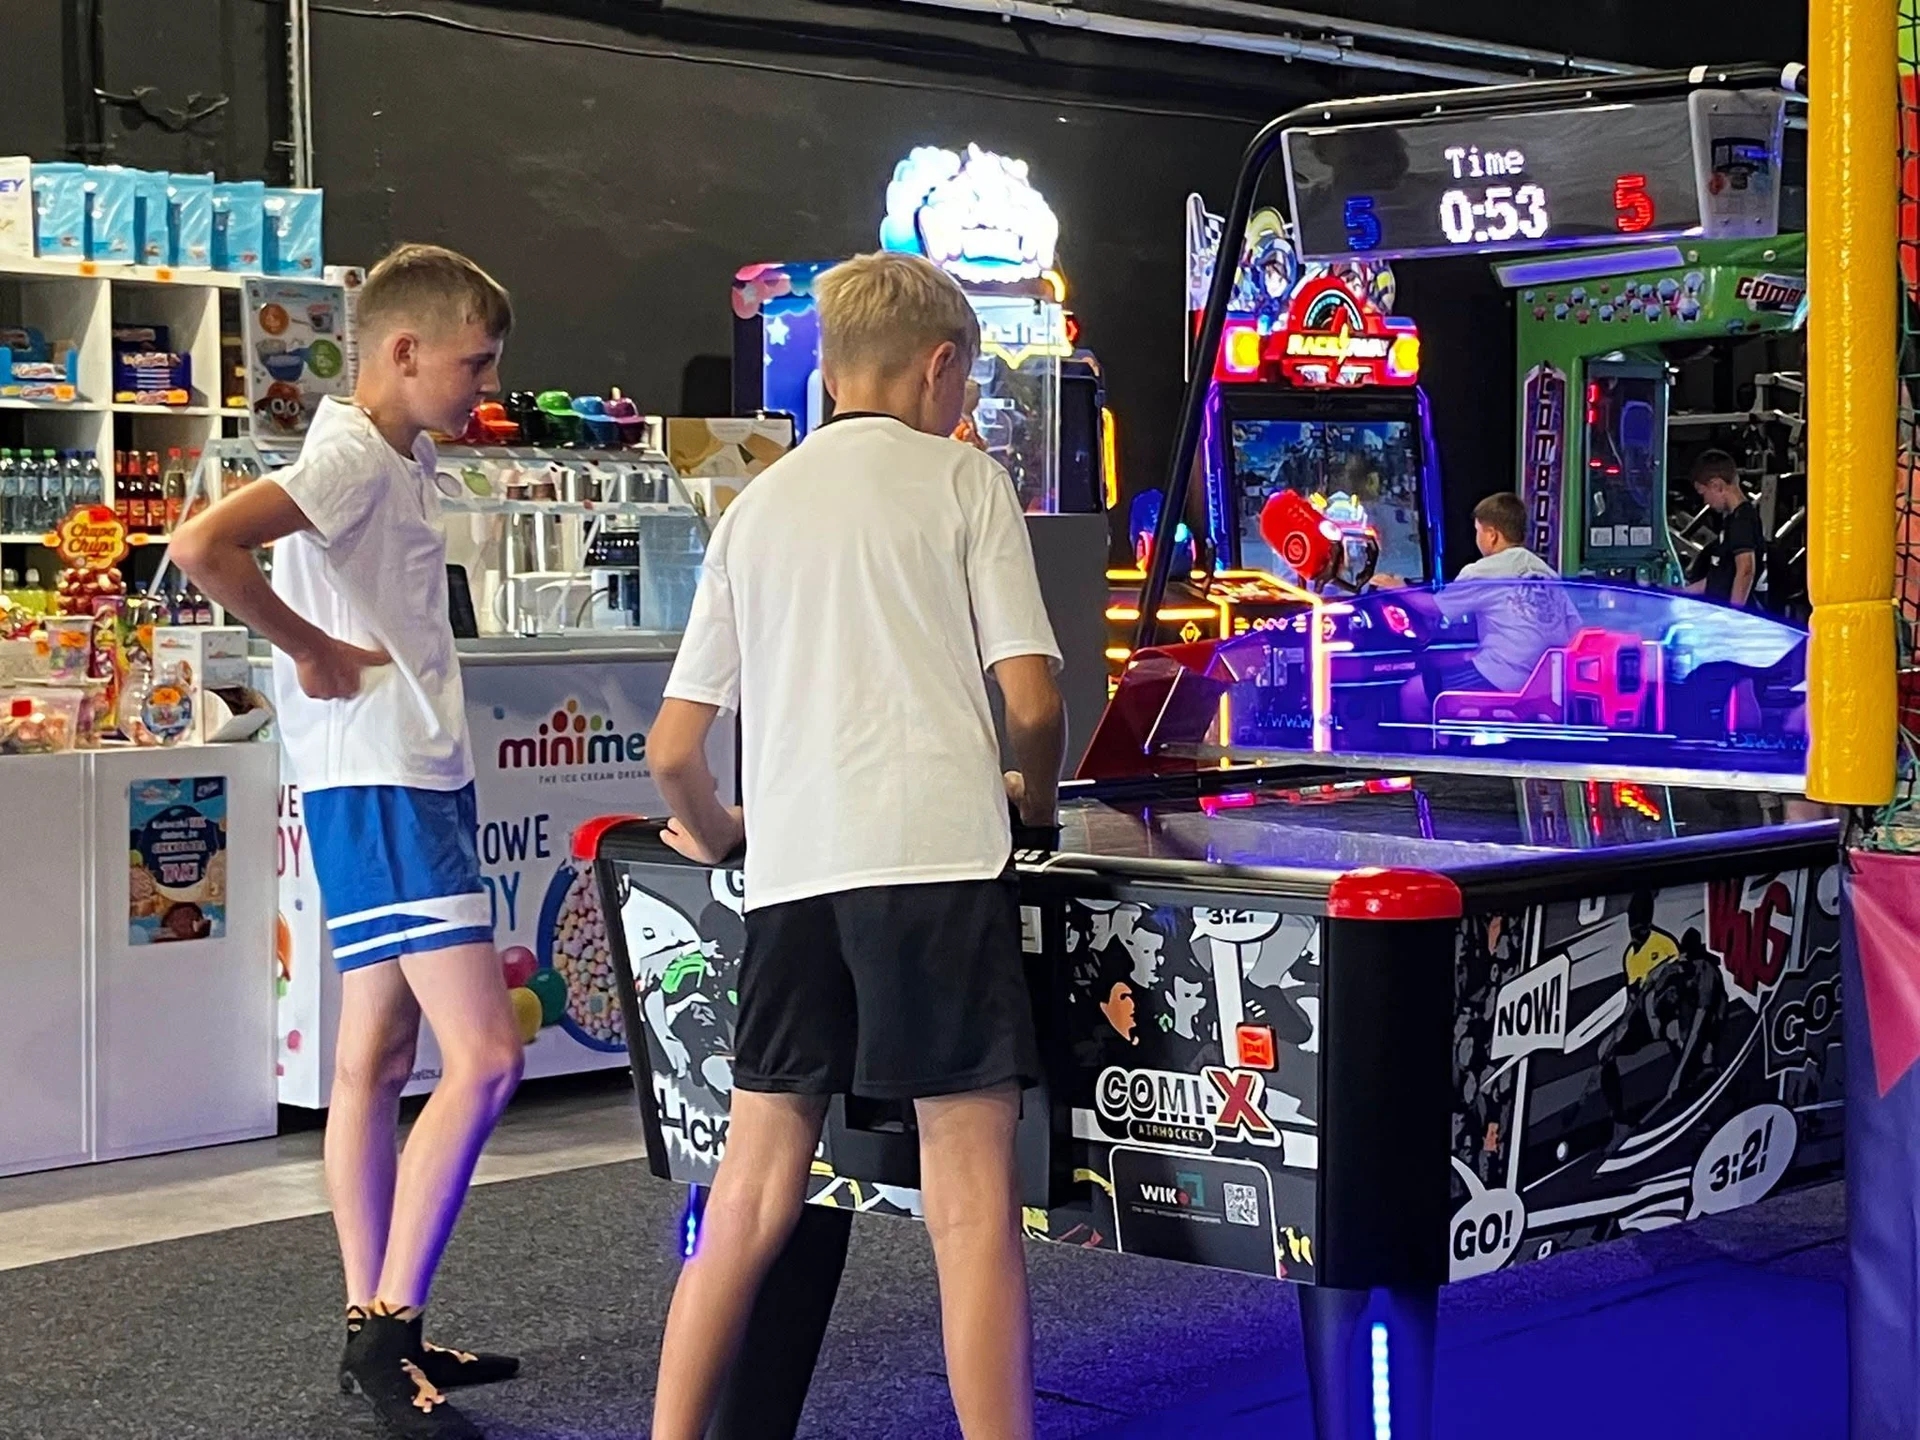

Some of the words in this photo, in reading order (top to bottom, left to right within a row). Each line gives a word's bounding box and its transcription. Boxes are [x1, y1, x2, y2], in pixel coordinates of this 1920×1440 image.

[1444, 145, 1525, 179] Time
[1345, 196, 1381, 251] 5
[1440, 184, 1548, 243] 0:53
[1614, 174, 1654, 232] 5
[1735, 276, 1806, 305] COMB
[68, 538, 115, 553] Chups
[70, 523, 117, 541] Chupa
[538, 775, 557, 784] THE
[560, 774, 577, 783] ICE
[580, 772, 615, 782] CREAM
[617, 769, 651, 780] DREAM
[475, 813, 551, 865] OWE
[1498, 973, 1562, 1037] NOW!
[1137, 1123, 1204, 1142] AIRHOCKEY
[1708, 1114, 1775, 1192] 3:2!
[1139, 1183, 1178, 1204] WIK
[1453, 1209, 1514, 1261] GO!
